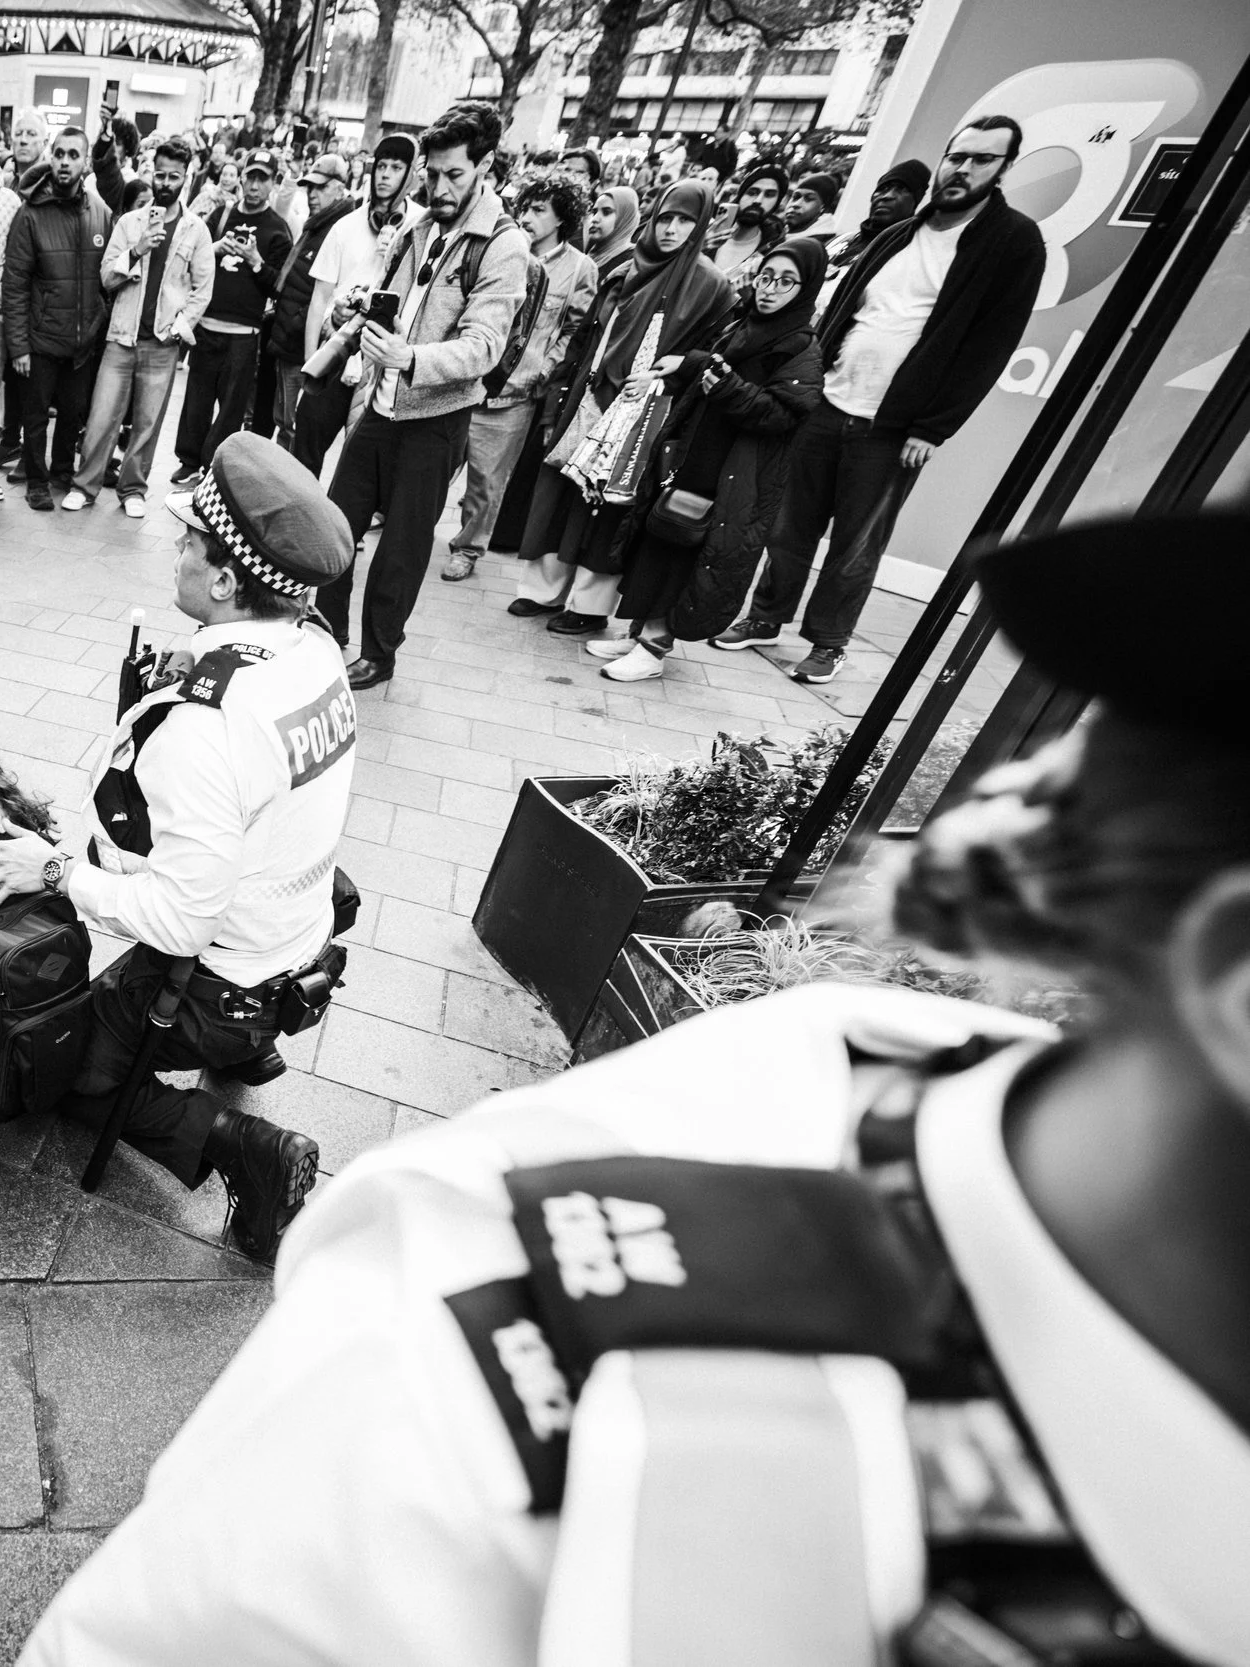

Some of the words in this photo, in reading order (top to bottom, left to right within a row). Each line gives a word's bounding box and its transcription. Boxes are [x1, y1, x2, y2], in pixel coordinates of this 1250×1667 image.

[232, 643, 262, 656] POLICE
[190, 684, 214, 701] 1356
[287, 690, 355, 775] POLICE
